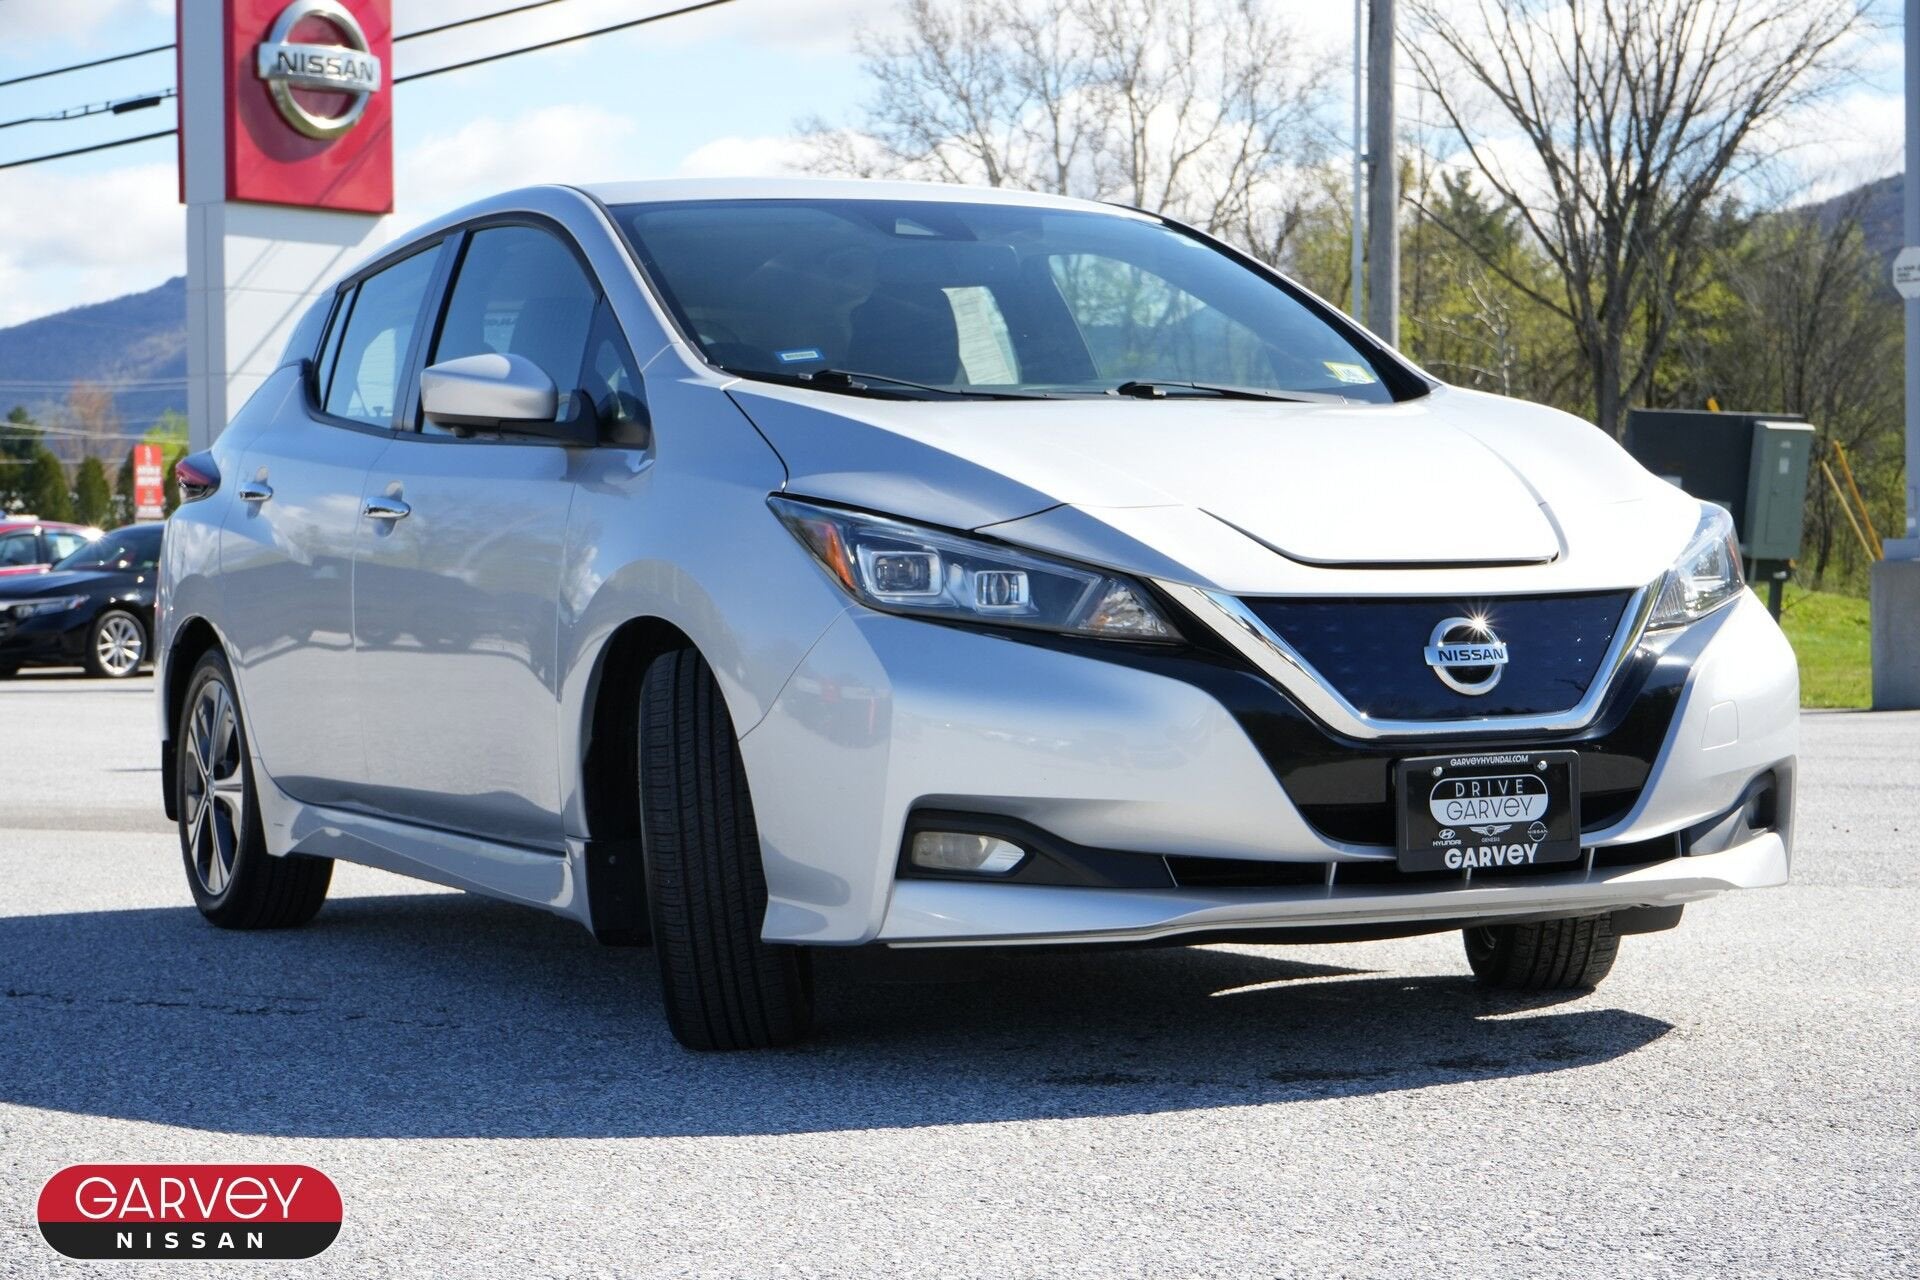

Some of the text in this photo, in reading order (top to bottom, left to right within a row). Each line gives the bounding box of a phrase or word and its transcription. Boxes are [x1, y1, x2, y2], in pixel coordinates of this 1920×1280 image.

[277, 51, 374, 81] NISSAN
[1438, 648, 1504, 662] NISSAN
[1455, 779, 1524, 797] DRIVE
